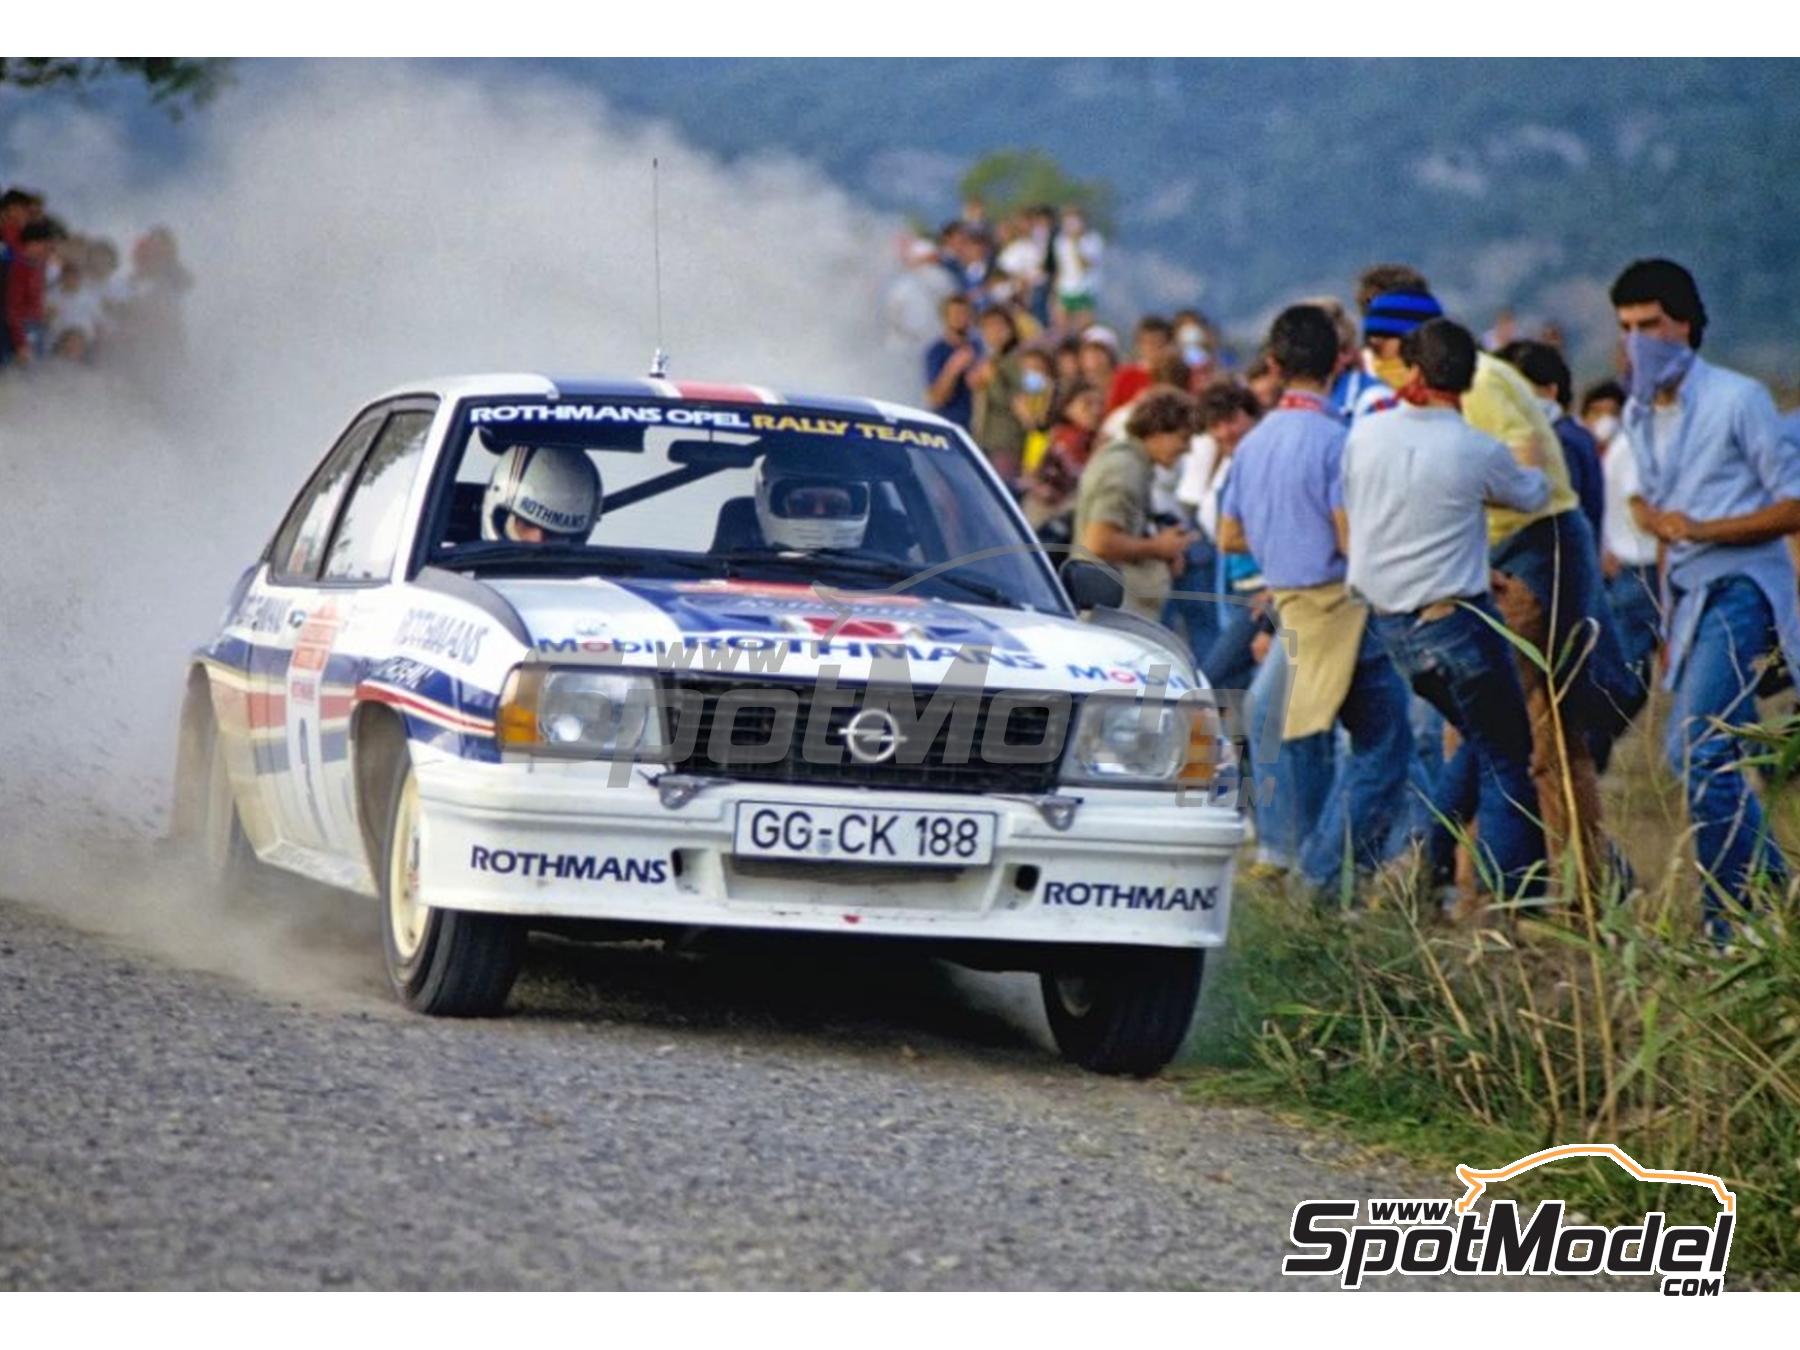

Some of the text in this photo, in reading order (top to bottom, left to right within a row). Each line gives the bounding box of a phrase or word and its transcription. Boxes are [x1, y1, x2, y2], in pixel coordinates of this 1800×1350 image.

[470, 405, 949, 450] ROTHMANS OPEL RALLY TEAM
[521, 496, 586, 529] ROTHMANS
[537, 637, 666, 654] Mobil
[683, 636, 1046, 670] ROTHMANS
[1066, 663, 1189, 690] Mobil
[751, 808, 979, 858] GG-CK 188
[470, 845, 668, 884] ROTHMANS
